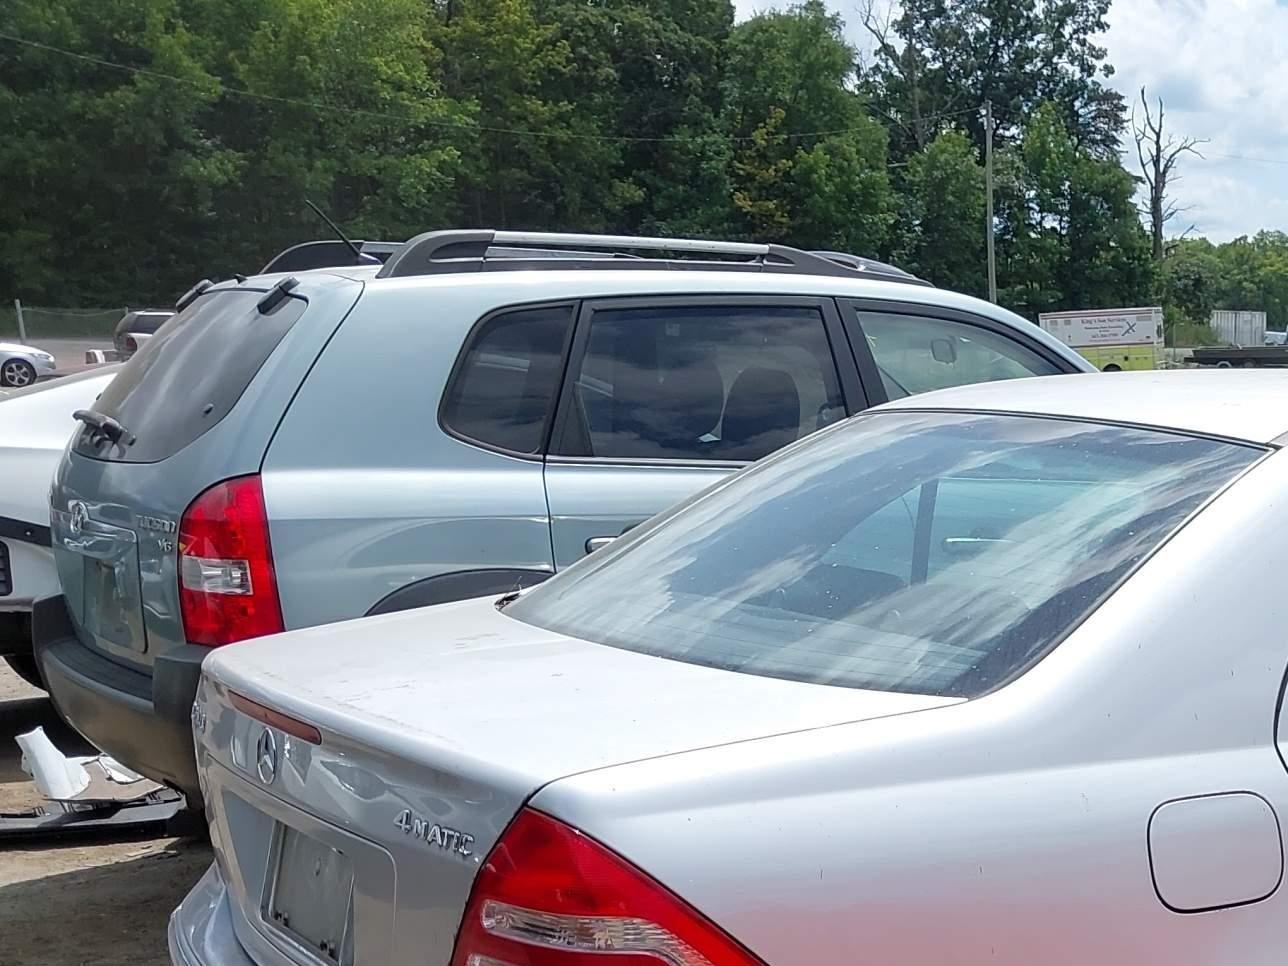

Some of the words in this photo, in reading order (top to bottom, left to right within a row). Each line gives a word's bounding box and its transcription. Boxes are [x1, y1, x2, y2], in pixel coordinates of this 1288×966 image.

[136, 514, 176, 533] TUCSON
[158, 538, 172, 552] V6
[393, 809, 475, 856] 4MATIC
